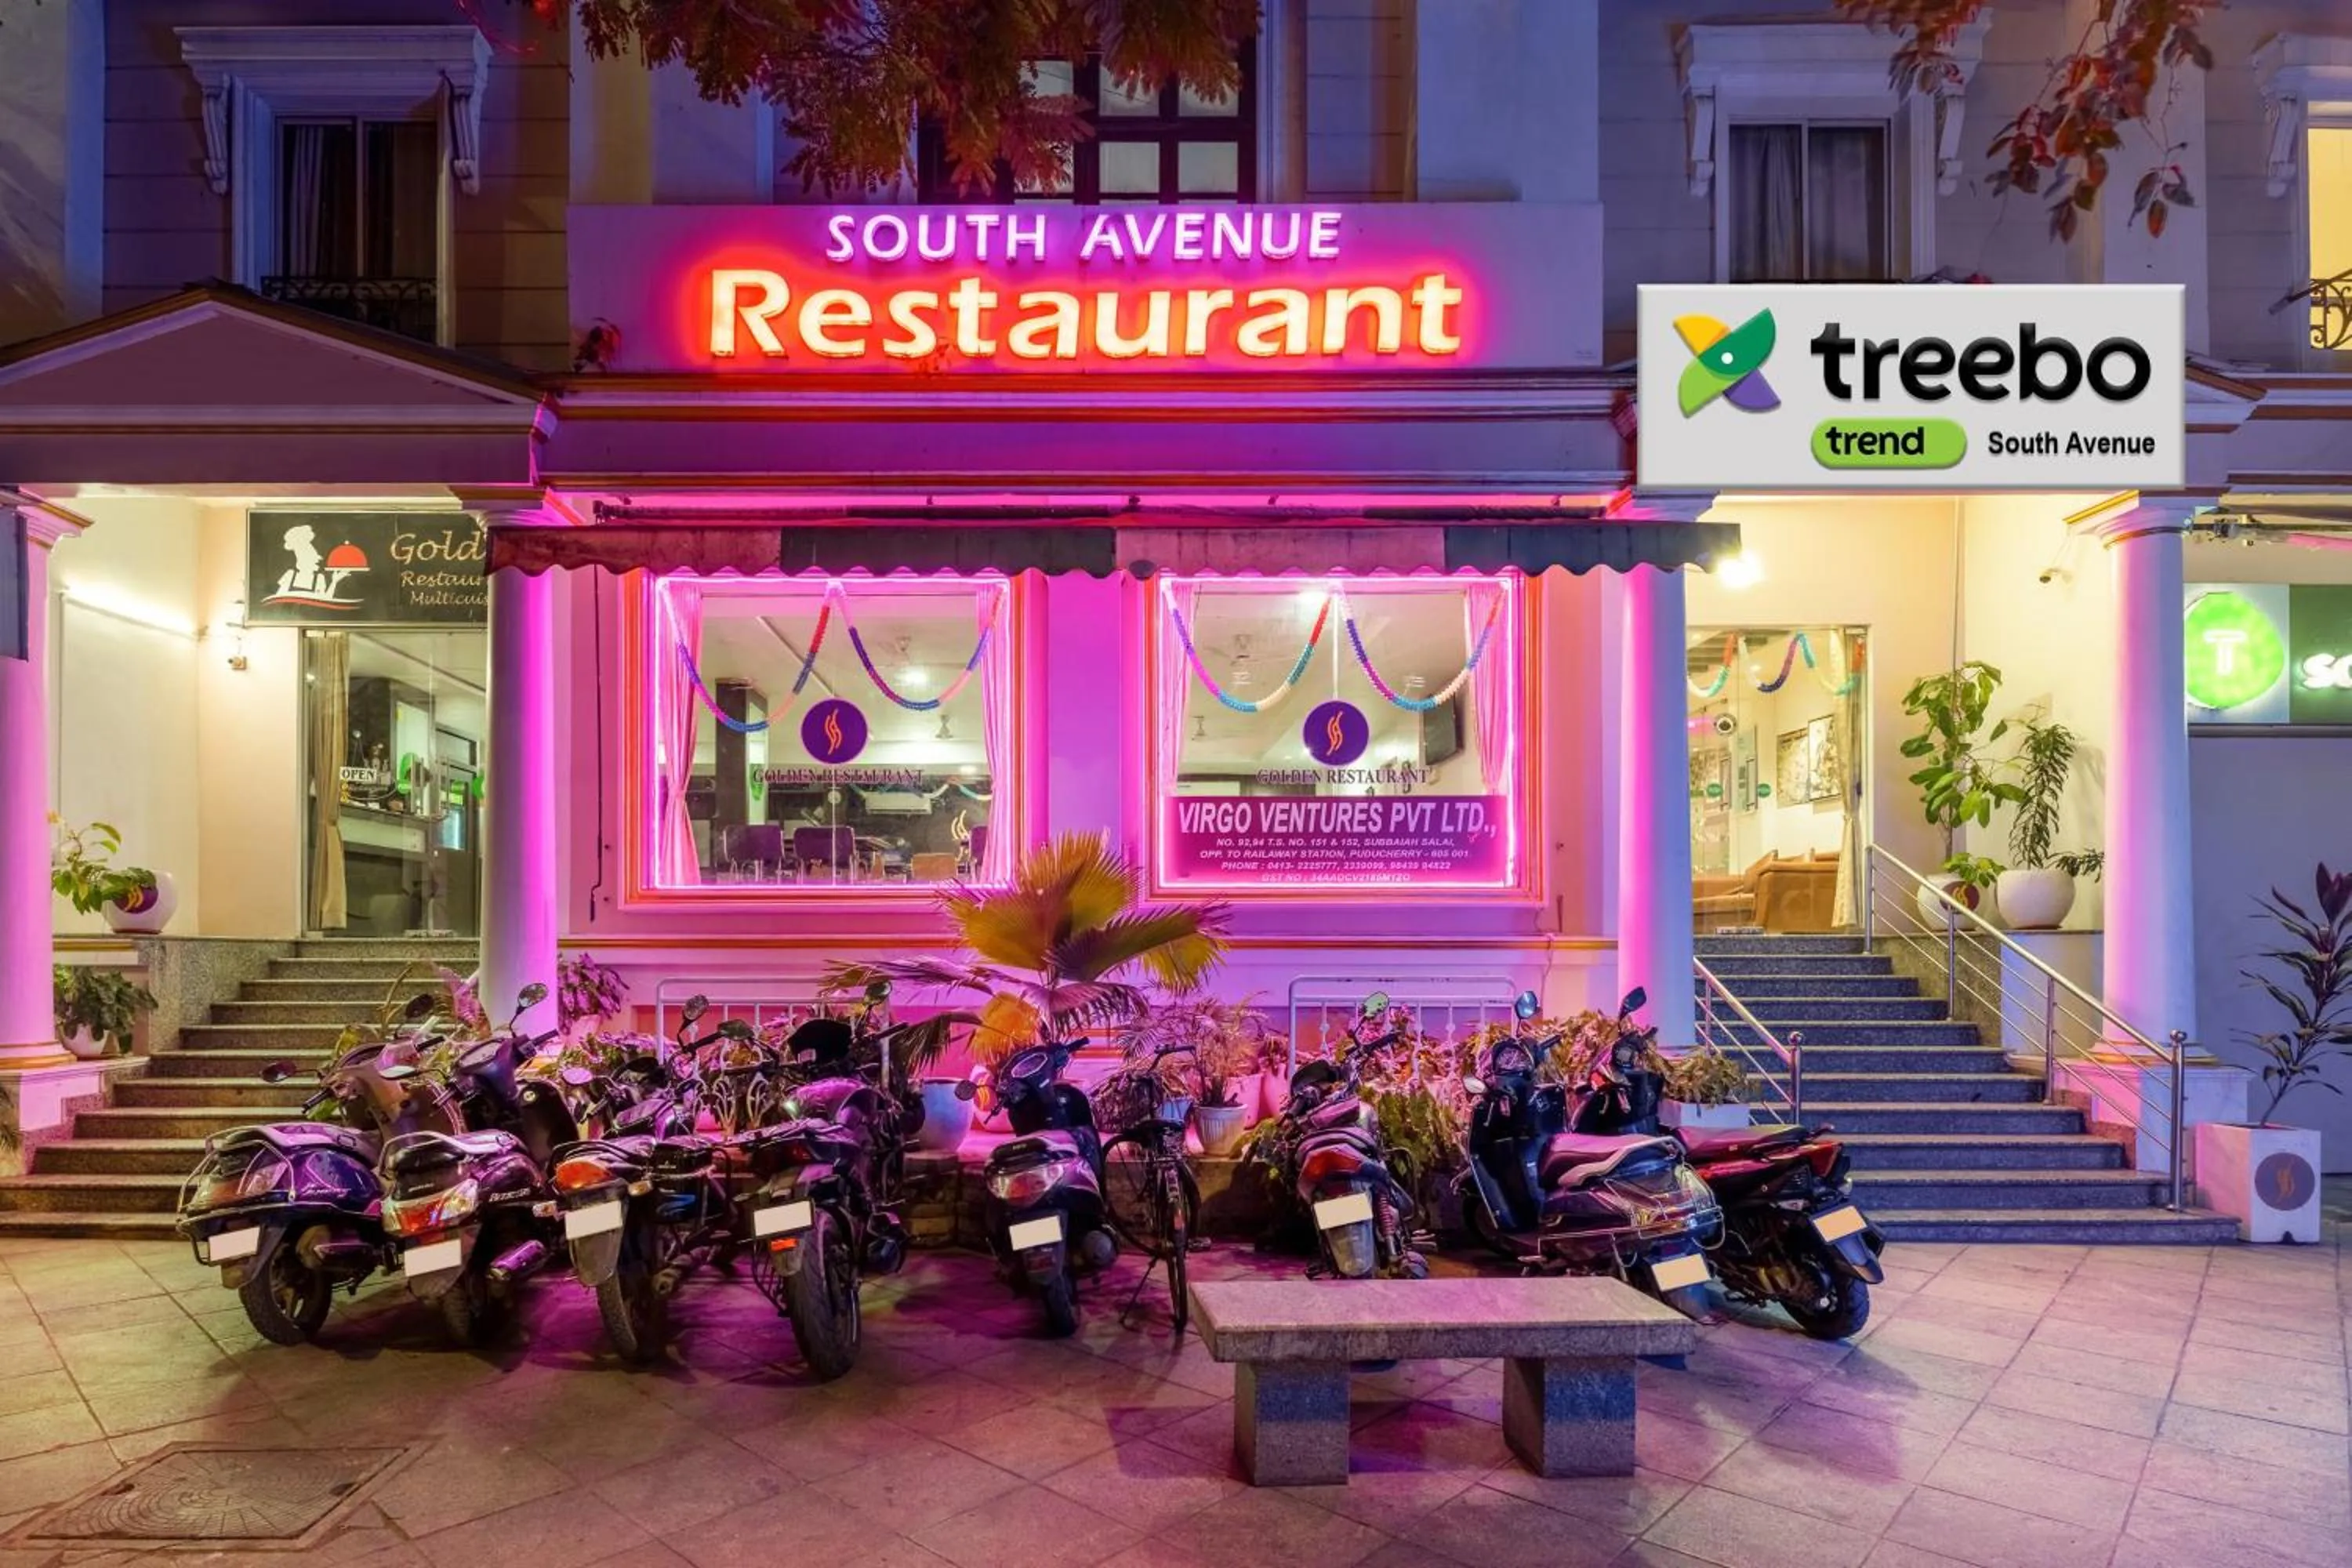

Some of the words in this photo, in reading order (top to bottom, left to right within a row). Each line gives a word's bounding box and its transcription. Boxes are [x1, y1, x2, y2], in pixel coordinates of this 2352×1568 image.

[827, 213, 1047, 262] SOUTH
[1079, 211, 1342, 260] AVENUE
[710, 269, 1464, 358] Restaurant
[1810, 322, 2152, 402] treebo
[1826, 426, 1925, 456] trend
[1988, 430, 2058, 456] South
[2064, 430, 2156, 456] Avenue
[2202, 630, 2247, 677] T
[342, 769, 376, 780] OPEN
[1256, 769, 1321, 783] GOLDEN
[1327, 768, 1427, 783] RESTAURANT
[1178, 802, 1252, 834] VIRGO
[1259, 802, 1384, 833] VENTURES
[1389, 802, 1434, 833] PVT
[1441, 802, 1497, 837] LTD.,
[1300, 850, 1346, 858] STATION,
[1341, 838, 1360, 847] 152,
